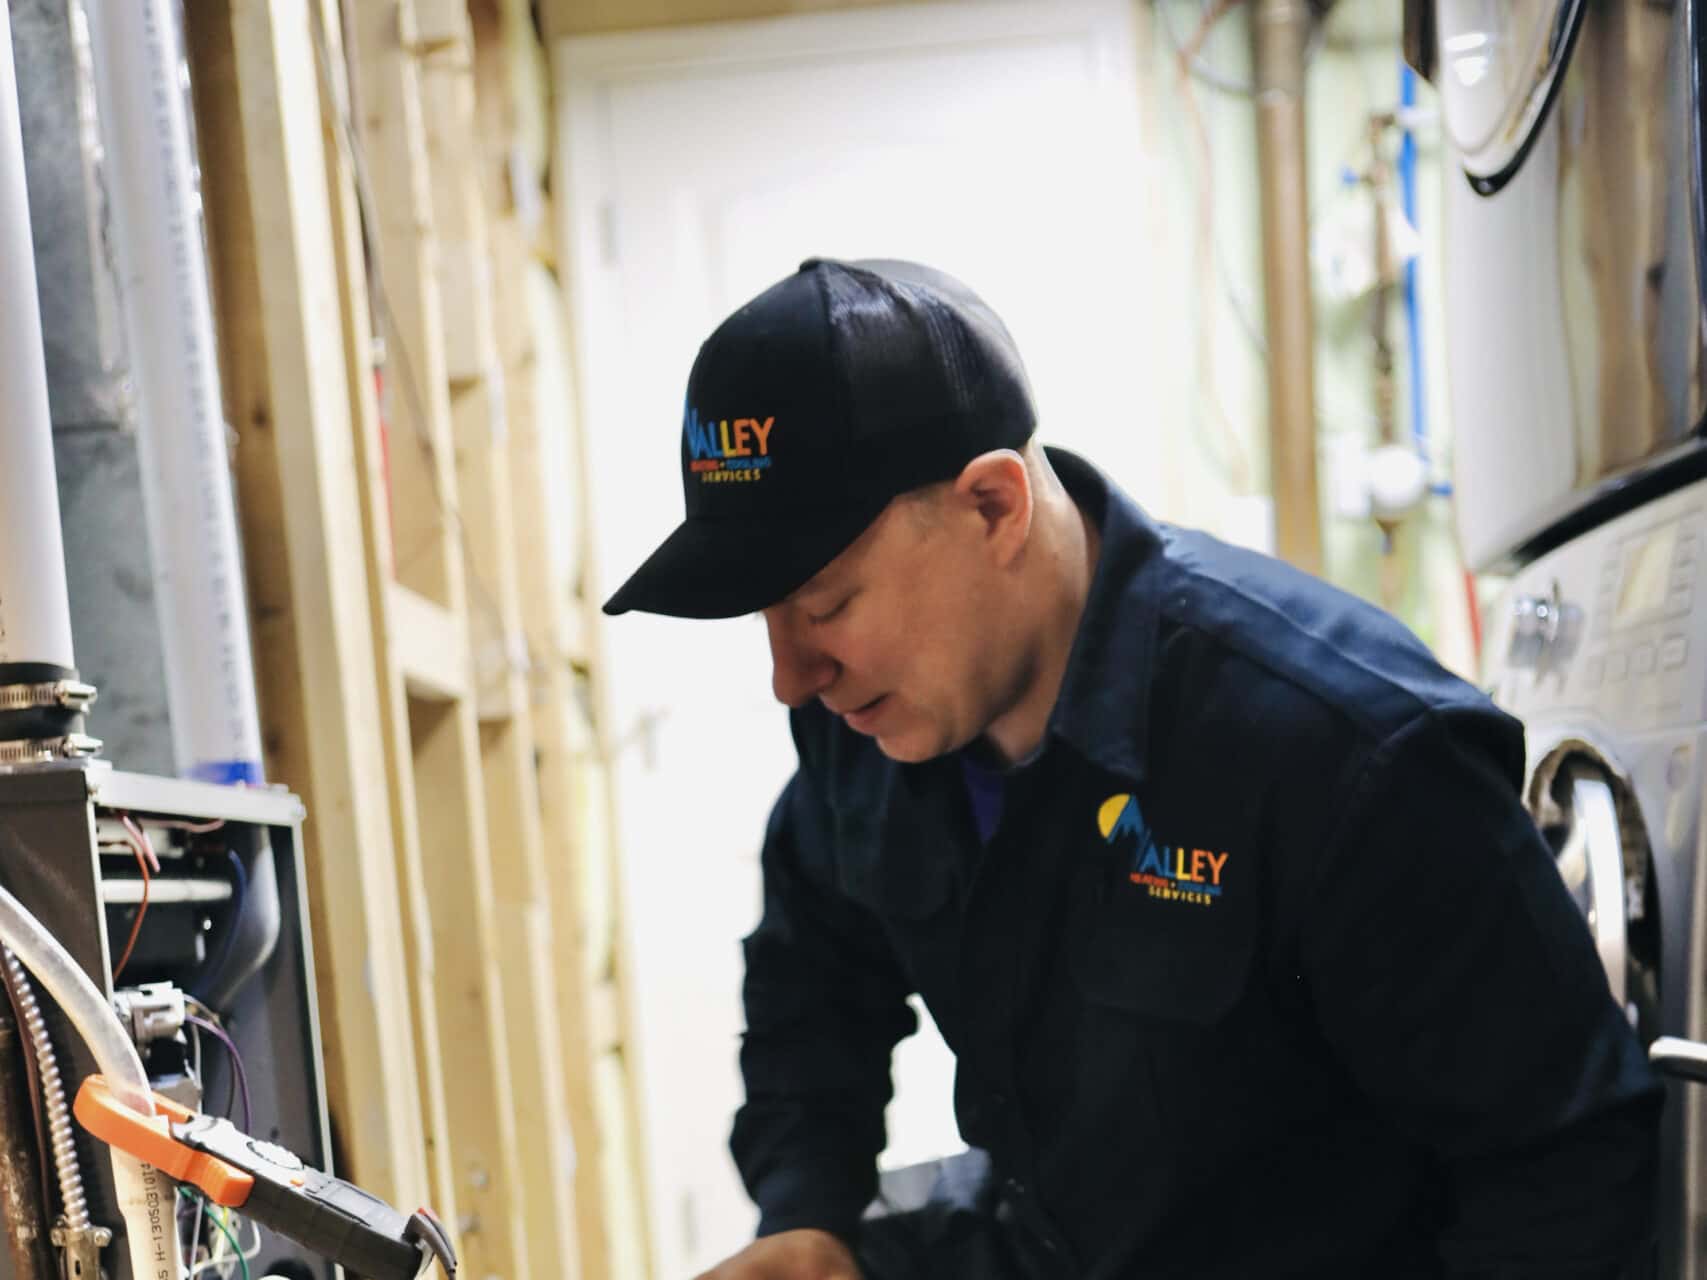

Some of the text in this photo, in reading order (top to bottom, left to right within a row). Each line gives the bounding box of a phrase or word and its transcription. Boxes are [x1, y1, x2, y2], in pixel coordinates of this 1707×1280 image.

[685, 408, 775, 458] VALLEY
[702, 468, 761, 482] SERVICES
[1136, 828, 1228, 885] VALLEY
[1148, 885, 1211, 905] SERVICES
